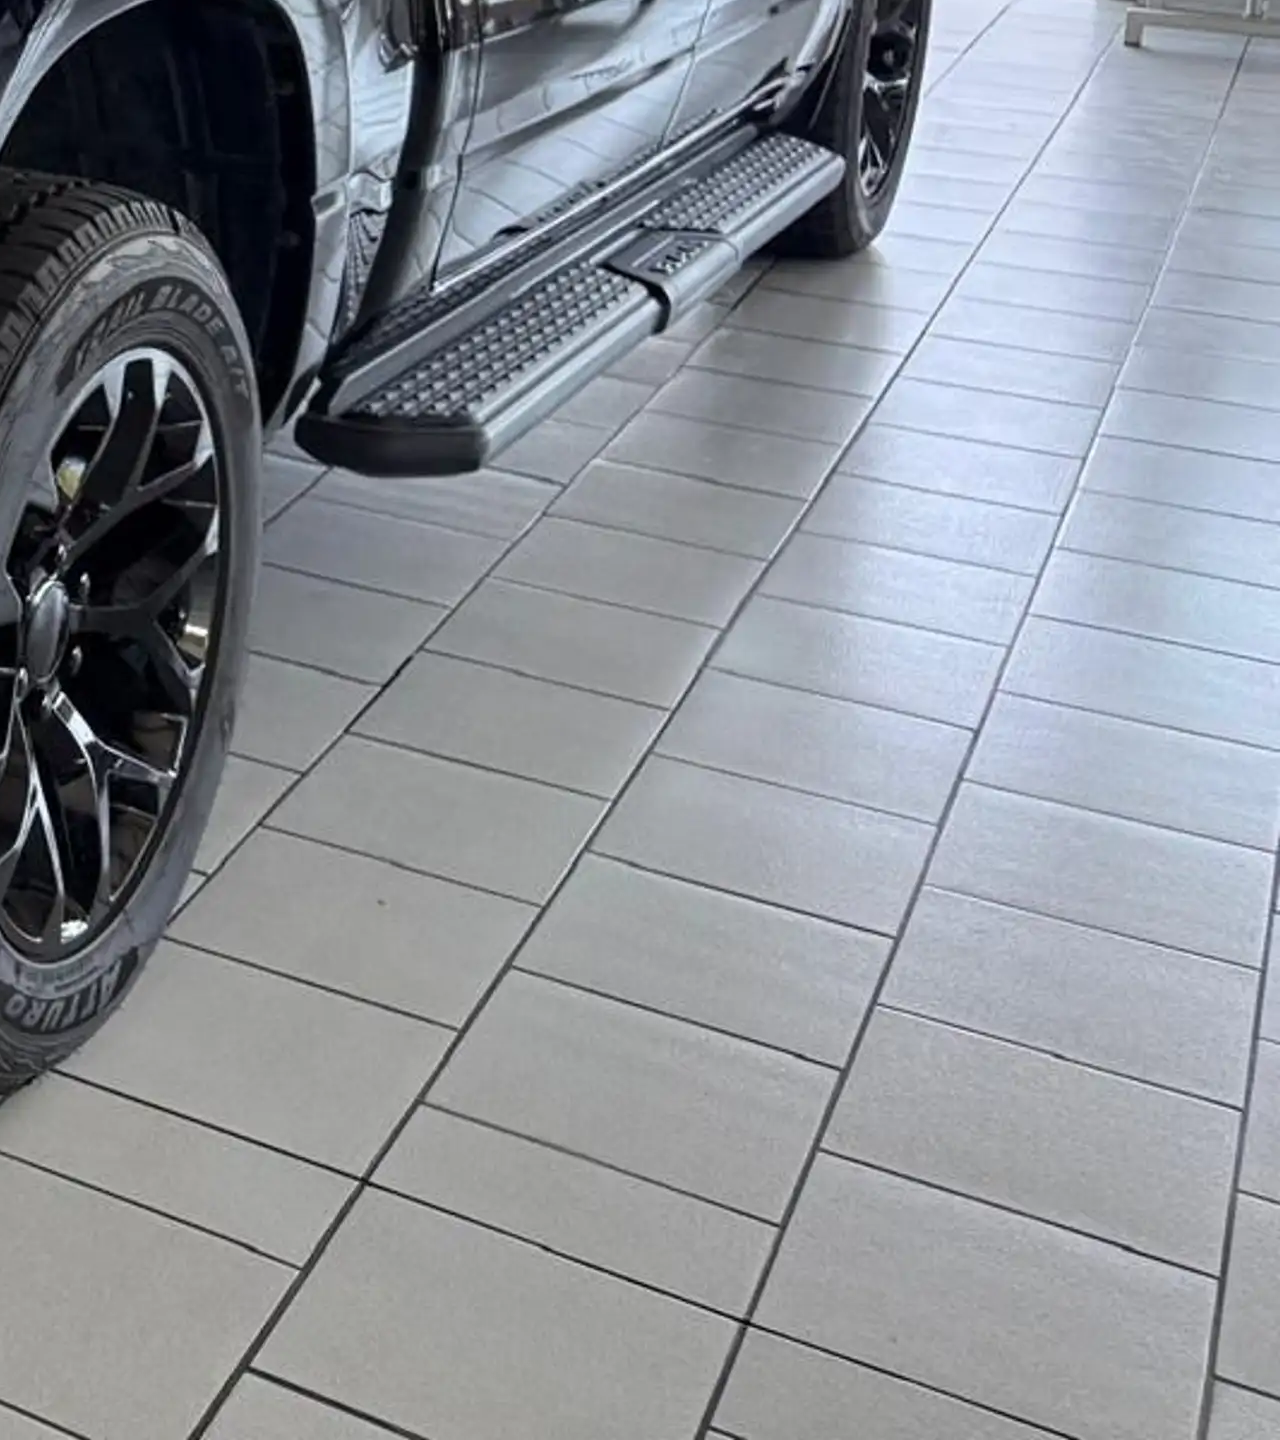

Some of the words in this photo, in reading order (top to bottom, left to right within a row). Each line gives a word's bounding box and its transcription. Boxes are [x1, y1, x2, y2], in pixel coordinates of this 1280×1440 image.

[75, 290, 146, 372] TRAIL
[149, 284, 226, 338] BLADE
[4, 959, 122, 1032] ATTURO
